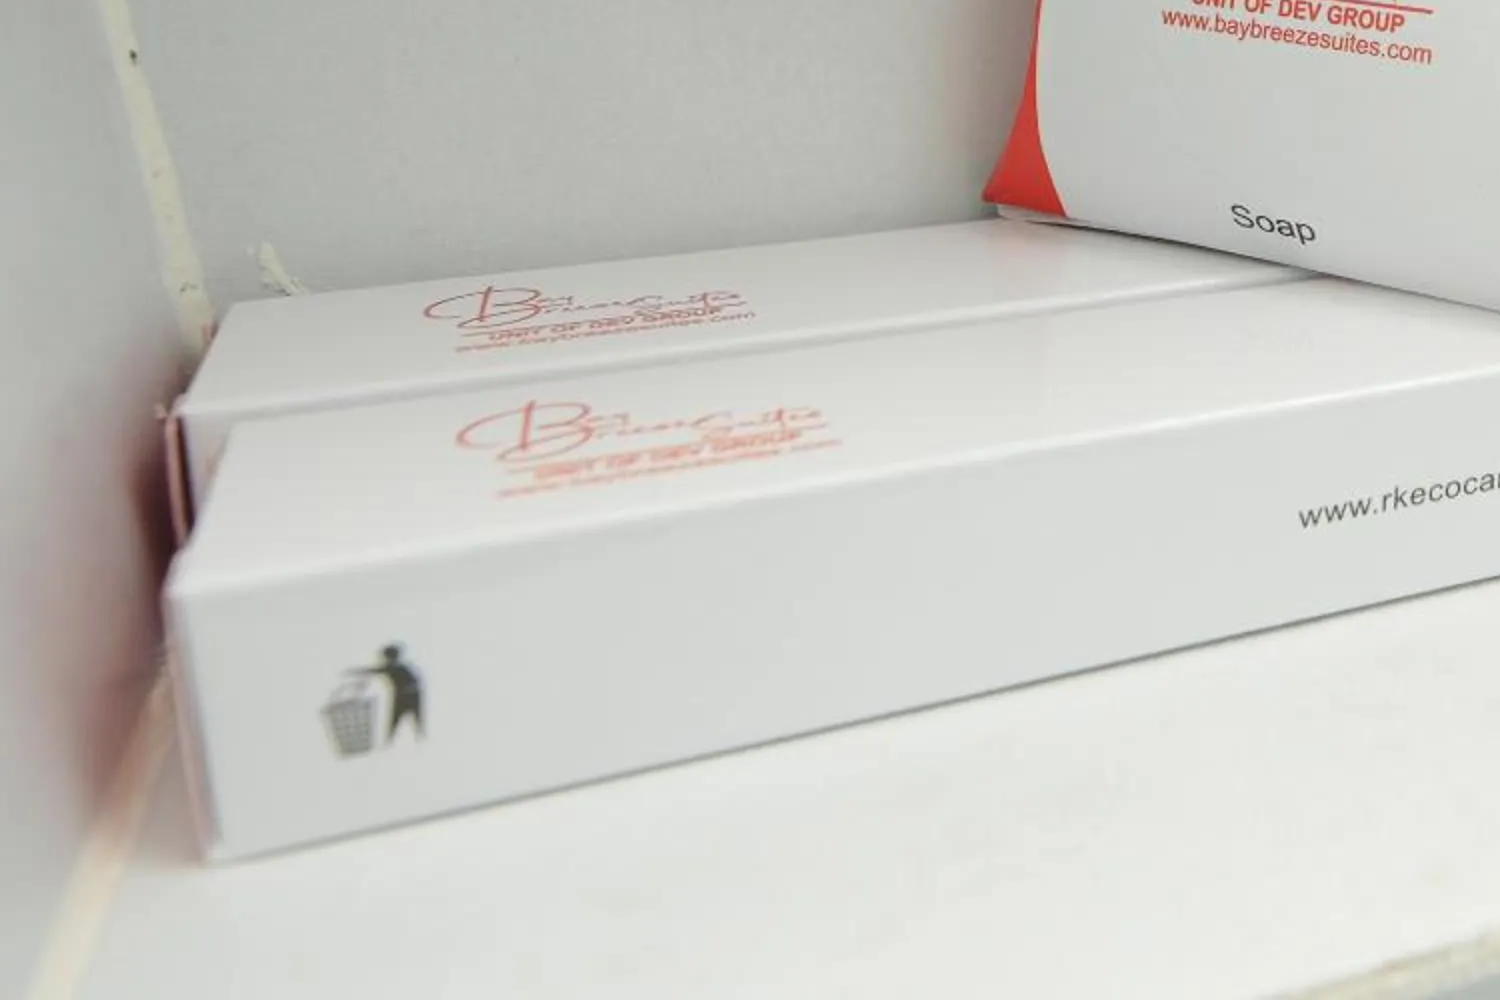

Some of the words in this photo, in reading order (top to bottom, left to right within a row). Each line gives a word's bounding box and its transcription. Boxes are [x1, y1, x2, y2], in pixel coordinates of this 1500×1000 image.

[1161, 7, 1432, 65] www.baybreezesuites.com
[1326, 4, 1406, 34] GROUP
[1231, 204, 1316, 245] Soap
